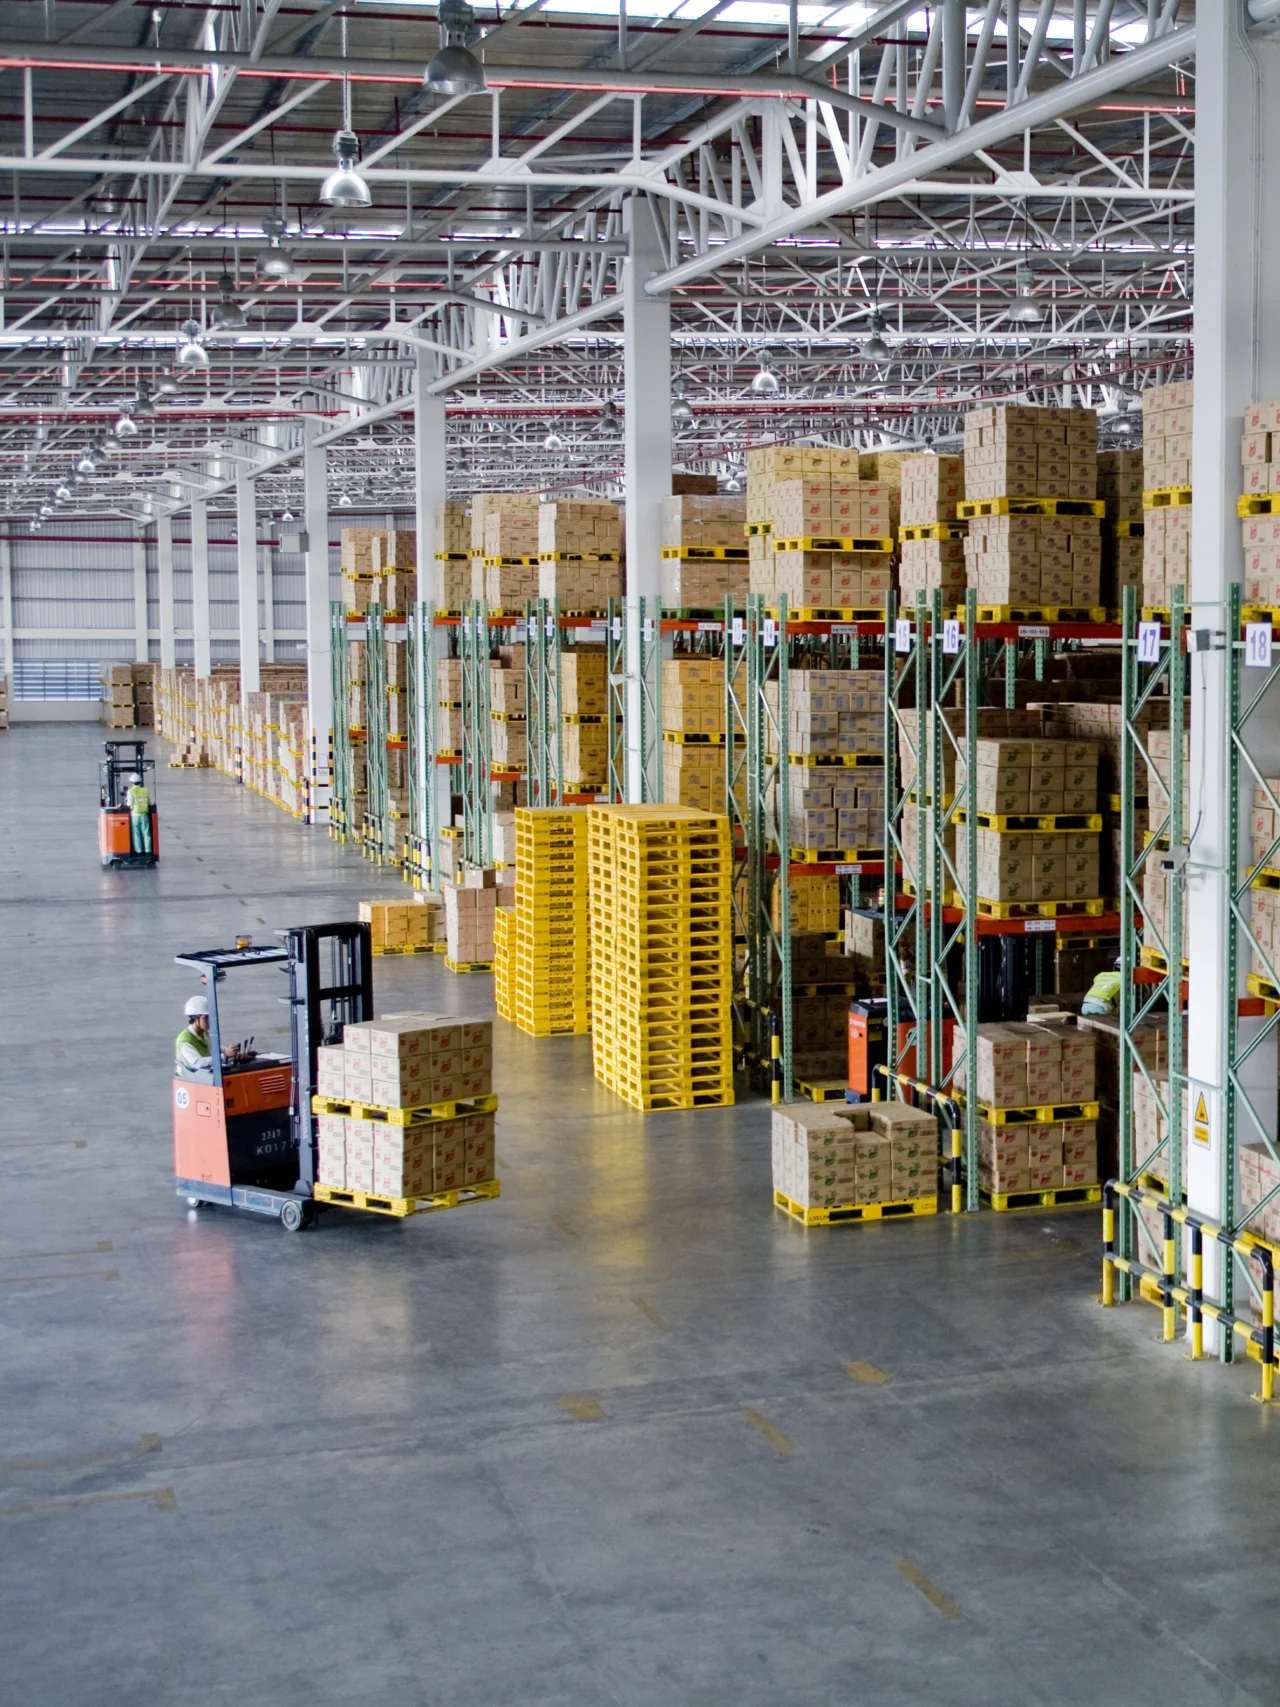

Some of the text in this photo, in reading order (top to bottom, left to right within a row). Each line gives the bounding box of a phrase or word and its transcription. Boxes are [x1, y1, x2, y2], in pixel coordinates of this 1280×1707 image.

[898, 625, 908, 648] 15
[946, 625, 957, 649] 16
[1019, 628, 1049, 636] 16-01-03
[1142, 628, 1157, 657] 17
[1250, 630, 1267, 661] 18
[177, 1092, 188, 1105] 05
[261, 1129, 281, 1141] 2317
